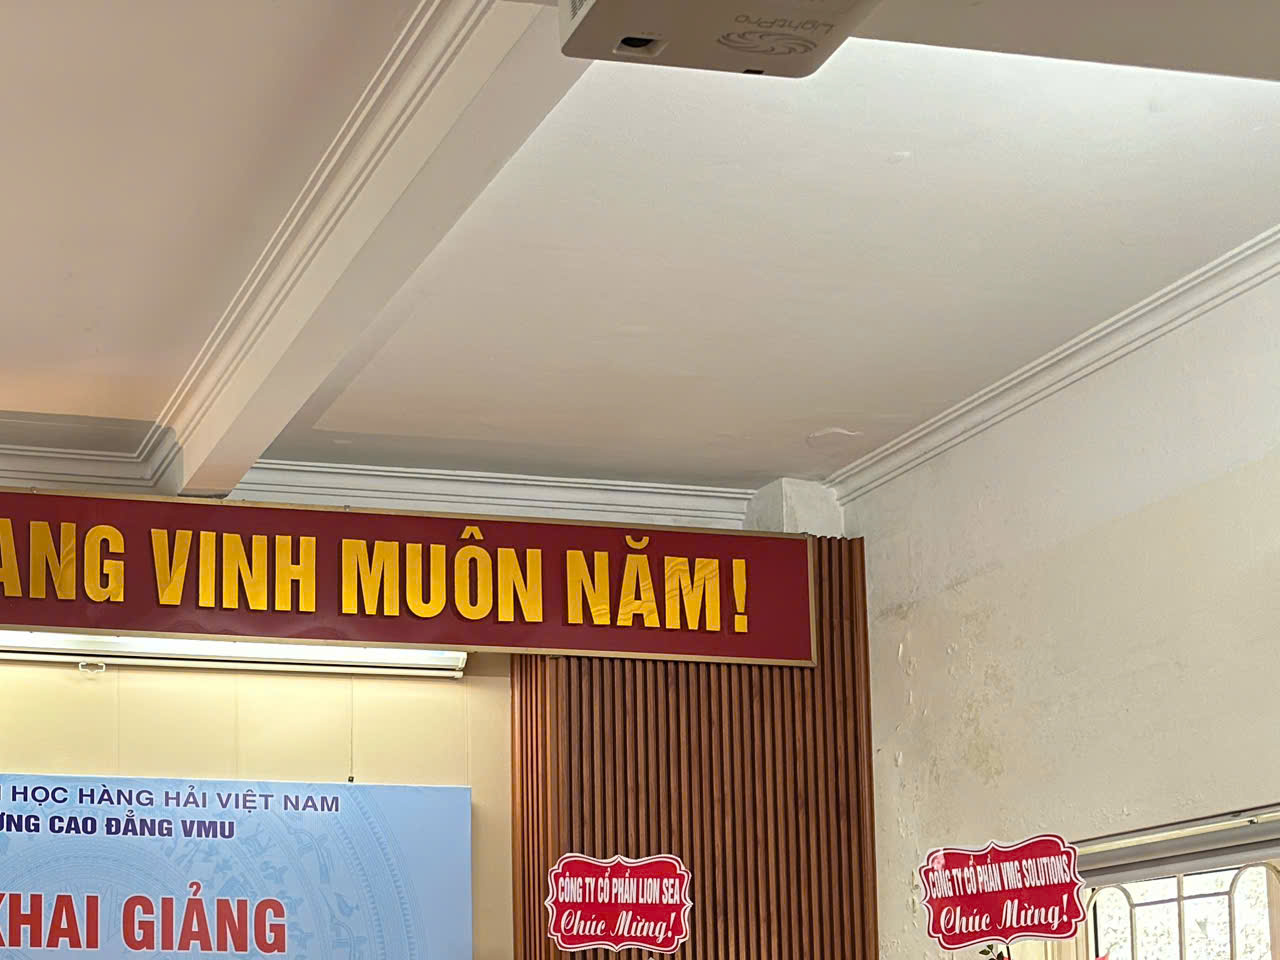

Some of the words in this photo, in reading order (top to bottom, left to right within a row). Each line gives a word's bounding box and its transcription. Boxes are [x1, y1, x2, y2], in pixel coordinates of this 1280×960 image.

[151, 528, 316, 612] VINH
[342, 525, 543, 623] MUÔN
[567, 535, 748, 633] NĂM!
[12, 785, 68, 806] HỌC
[79, 784, 154, 806] HÀNG
[164, 785, 207, 808] HẢI
[216, 789, 274, 813] VIỆT
[283, 795, 339, 812] NAM
[49, 816, 97, 835] CAO
[105, 810, 173, 837] ĐẲNG
[181, 820, 234, 839] VMU
[559, 872, 582, 903] CÔNG
[585, 877, 596, 903] TY
[598, 867, 610, 903] CỔ
[639, 877, 660, 904] LION
[662, 877, 680, 905] SEA
[952, 868, 964, 896] TY
[1000, 859, 1023, 890] VMG
[1022, 854, 1070, 887] SOLUTIONS
[122, 881, 286, 953] GIẢNG
[561, 909, 606, 936] Chúc
[610, 910, 676, 944] Mừng!
[939, 906, 992, 936] Chúc
[996, 894, 1068, 930] Mừng!
